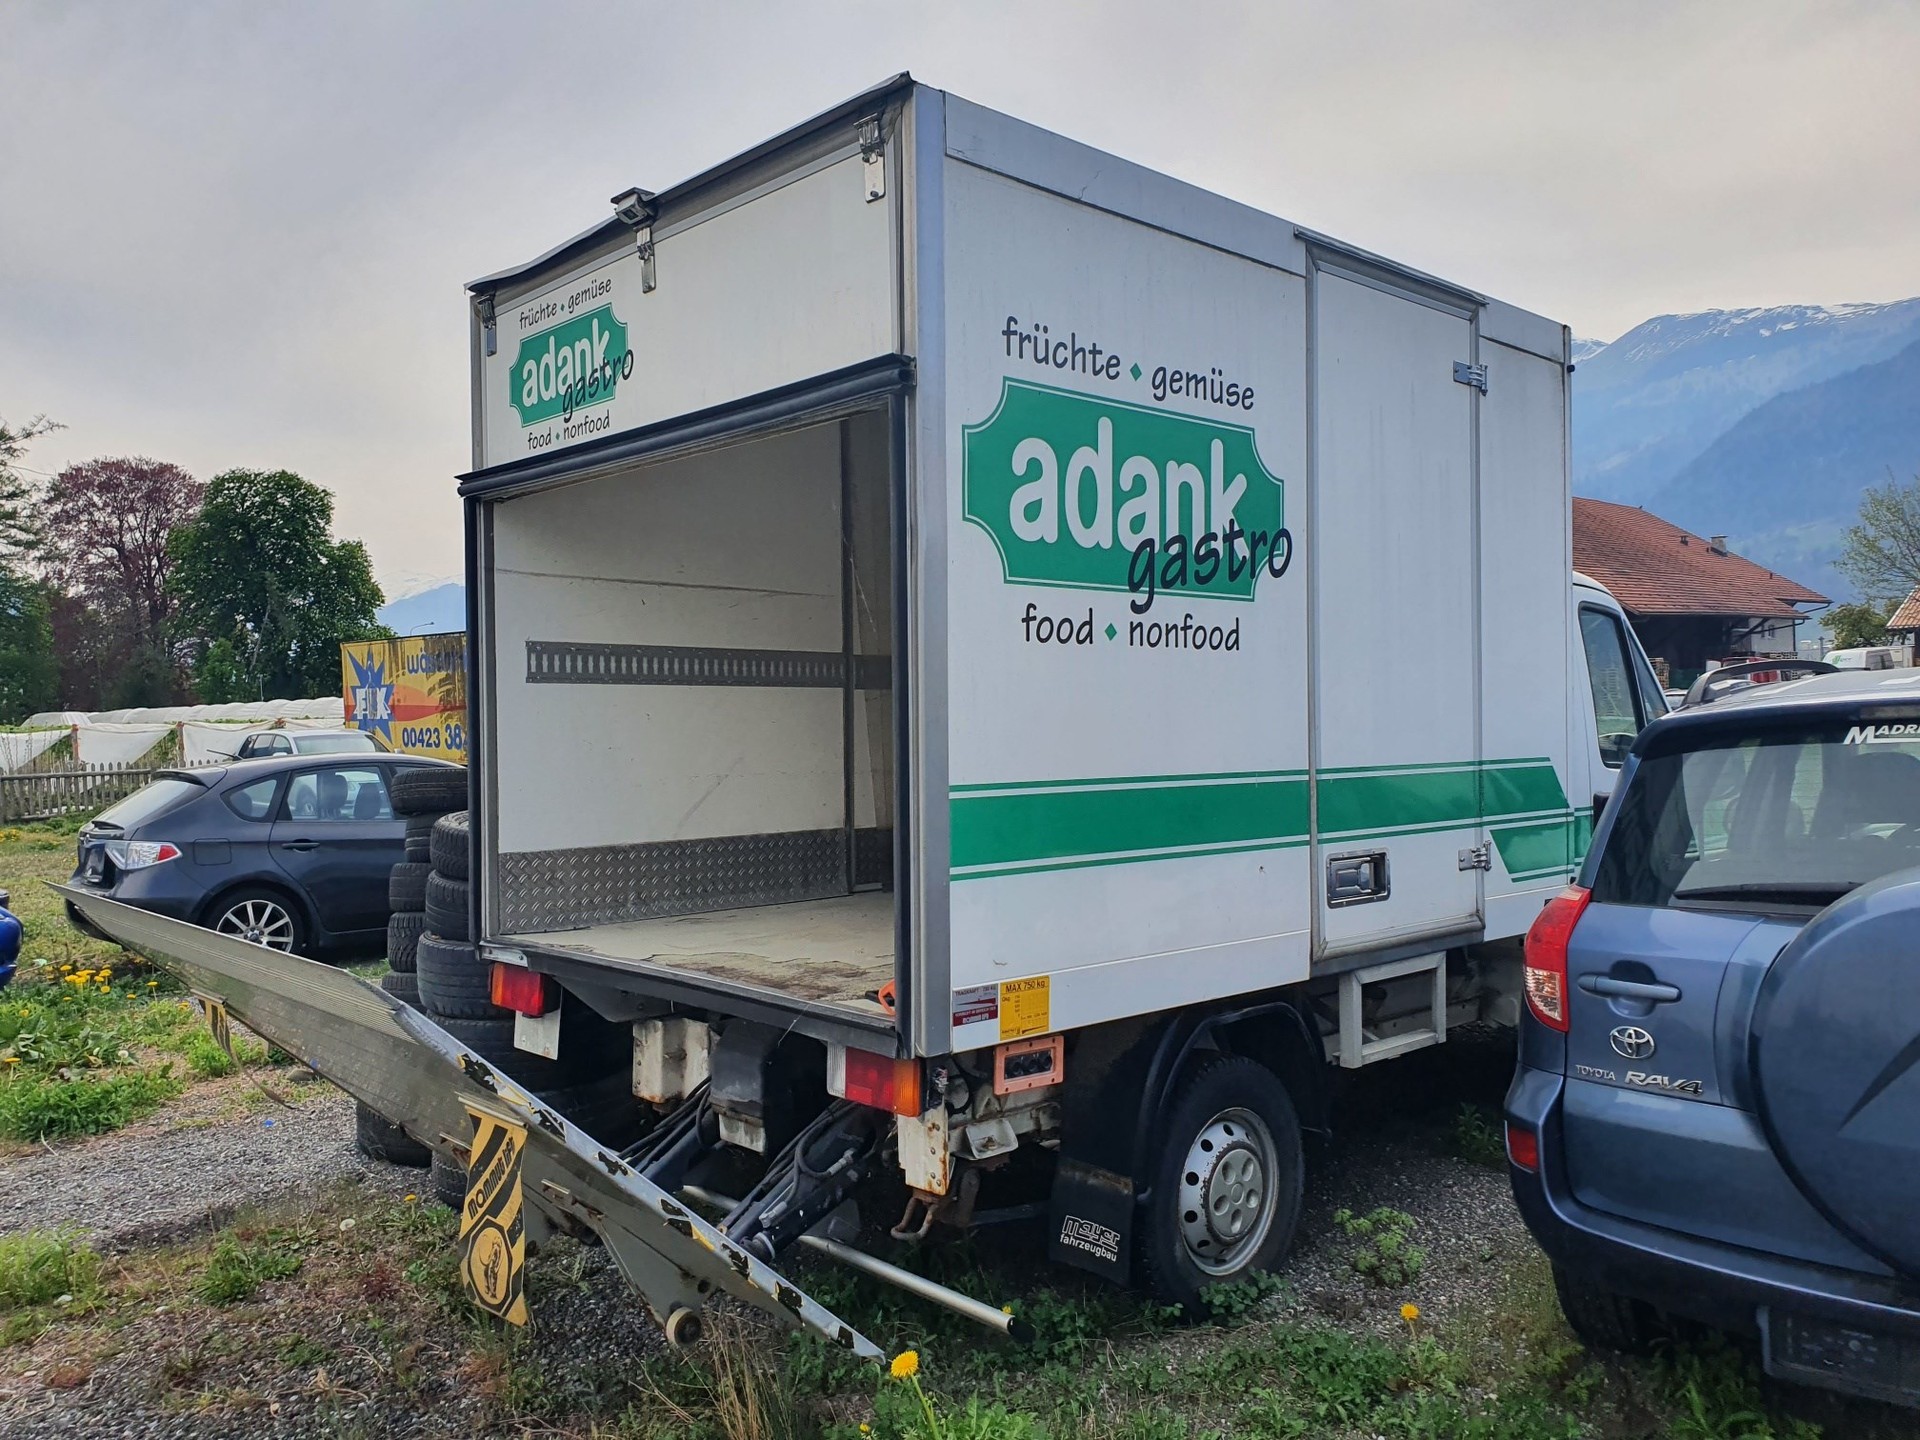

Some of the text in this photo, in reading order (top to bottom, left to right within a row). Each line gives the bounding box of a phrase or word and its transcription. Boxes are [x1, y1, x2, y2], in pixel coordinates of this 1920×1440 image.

[520, 278, 611, 329] früchte gemüse
[522, 318, 610, 408] adank
[562, 349, 633, 423] gastro
[1001, 315, 1255, 411] früchte gemüse
[528, 409, 611, 449] food nonfood
[1009, 416, 1249, 562] adank
[1127, 518, 1293, 614] gastro
[1021, 603, 1240, 651] food nonfood
[402, 723, 466, 750] 00423 38
[1842, 724, 1920, 746] MADR
[1006, 979, 1045, 993] MAX 750 kg
[1575, 1064, 1704, 1095] TOYOTA RAV4
[1060, 1233, 1117, 1262] fahrzeugbau
